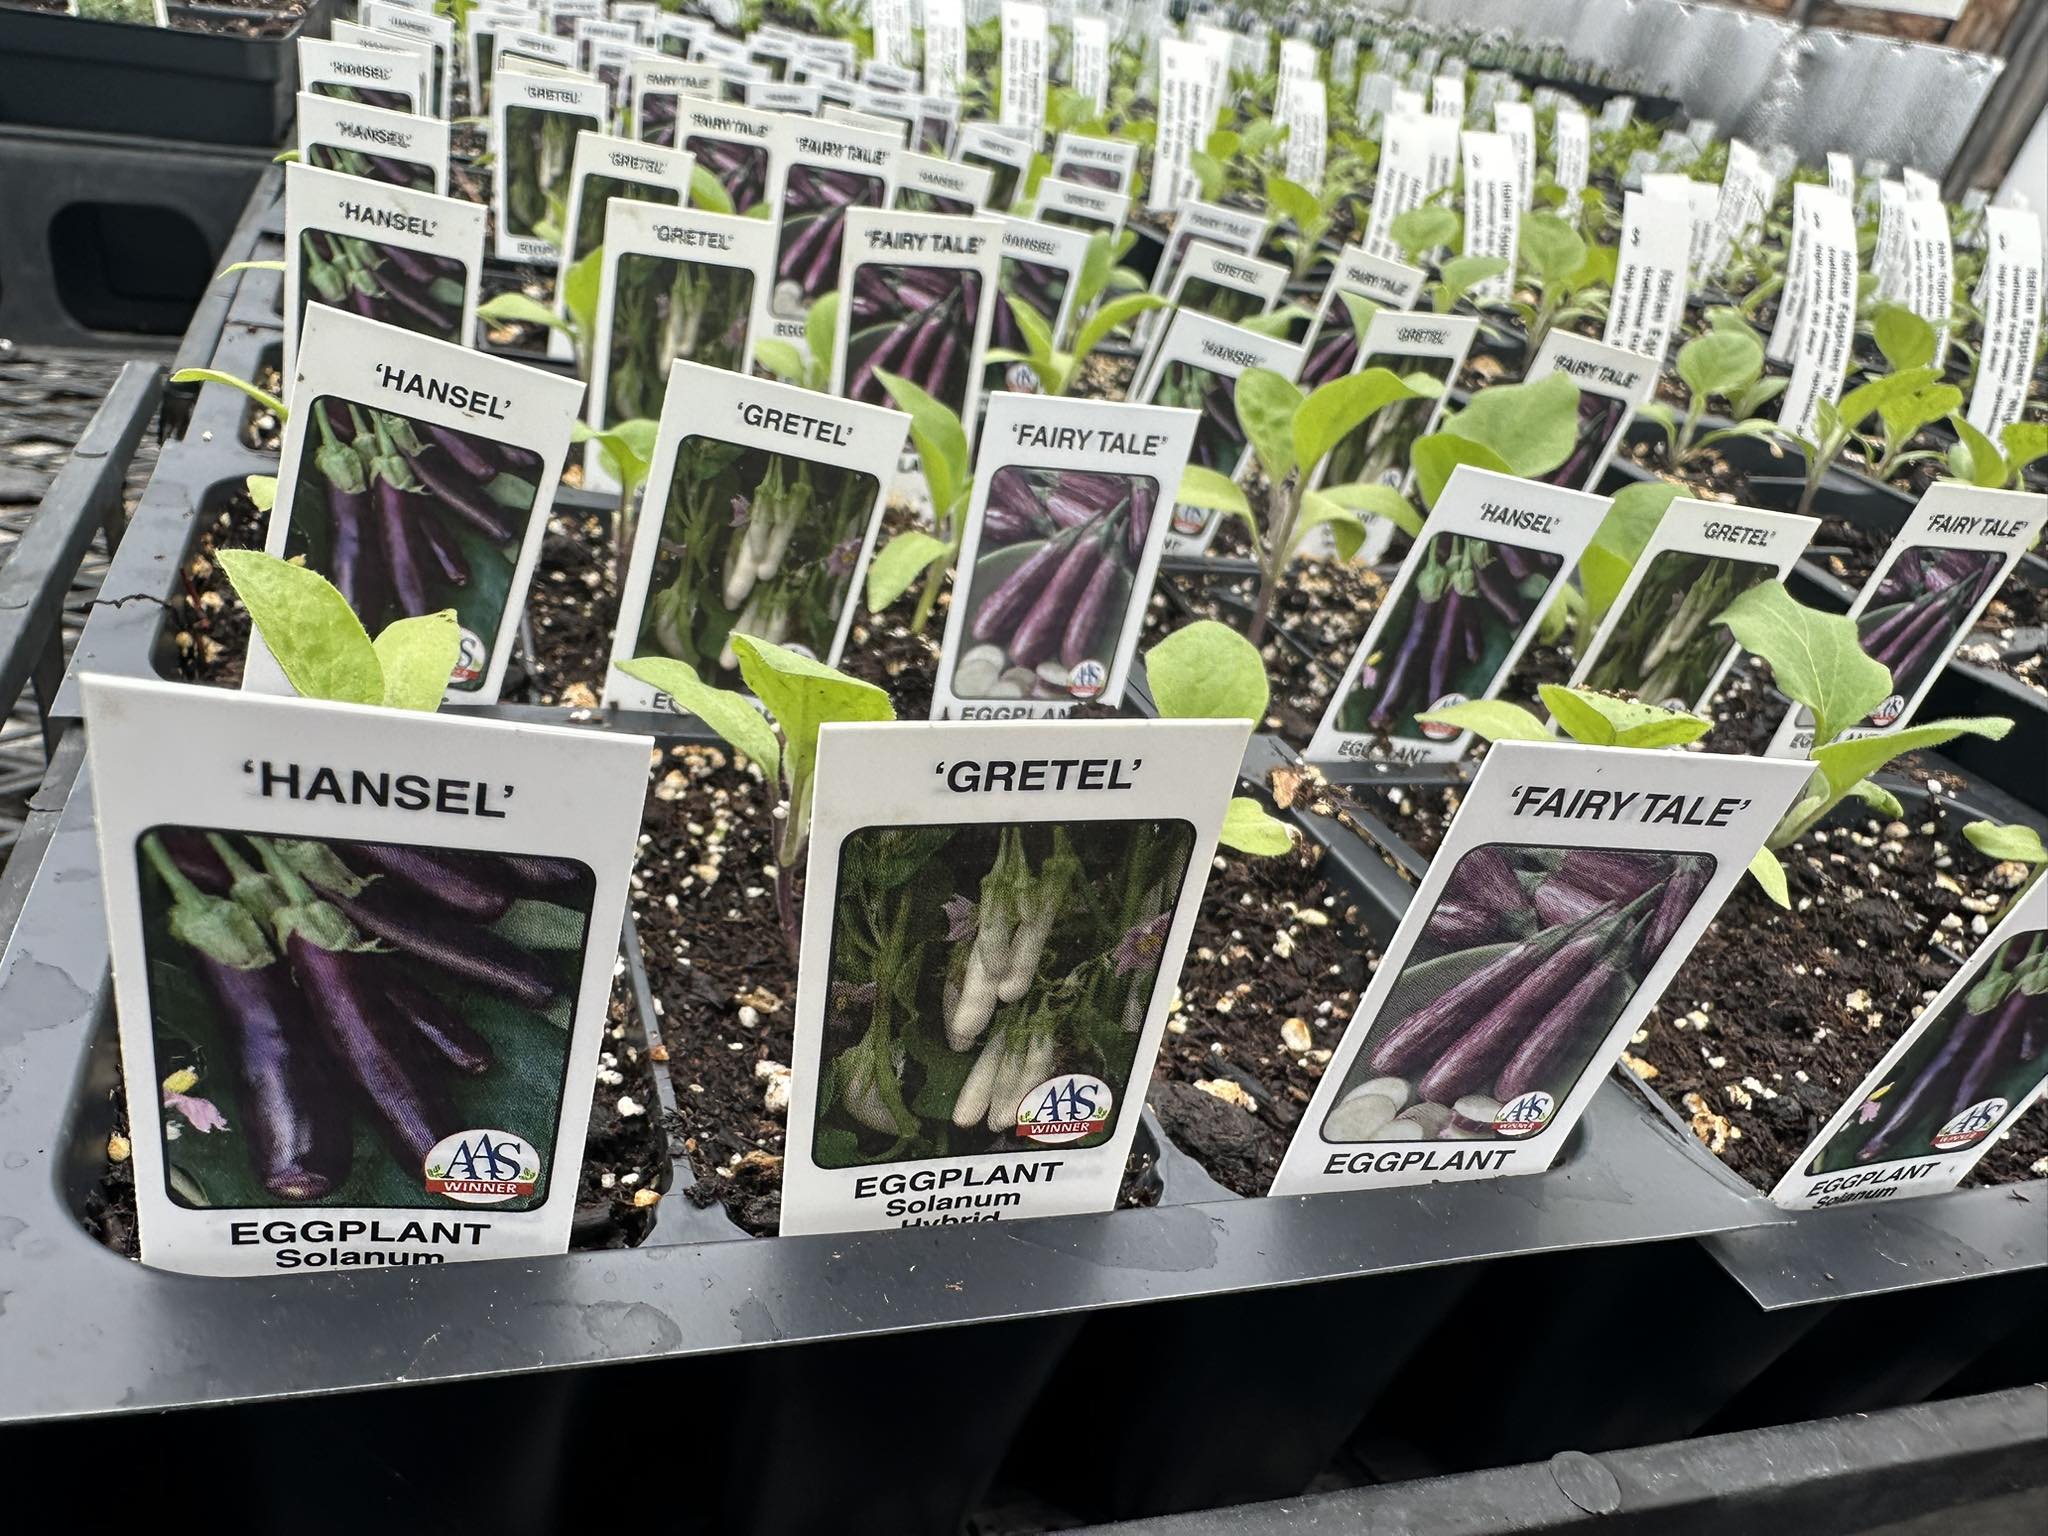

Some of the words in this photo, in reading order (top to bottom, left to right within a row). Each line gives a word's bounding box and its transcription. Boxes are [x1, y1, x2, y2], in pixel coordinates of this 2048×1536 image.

[338, 200, 438, 238] 'HANSEL'
[375, 362, 512, 421] 'HANSEL'
[736, 401, 854, 447] 'GRETEL'
[1011, 423, 1093, 452] 'FAIRY
[1098, 430, 1169, 457] TALE'
[1480, 502, 1561, 535] 'HANSEL'
[1702, 520, 1777, 547] 'GRETEL'
[1928, 513, 1979, 534] 'FAIRY
[1977, 517, 2029, 538] TALE'
[243, 758, 515, 820] 'HANSEL'
[935, 758, 1143, 793] 'GRETEL'
[1510, 784, 1640, 821] 'FAIRY
[1639, 792, 1752, 827] TALE'
[1030, 1078, 1100, 1122] AAS
[1501, 1092, 1550, 1122] AAS
[1029, 1121, 1091, 1134] WINNER
[443, 1132, 522, 1181] AAS
[1323, 1150, 1517, 1175] EGGPLANT
[443, 1179, 518, 1195] WINNER
[854, 1161, 1064, 1199] EGGPLANT
[1806, 1161, 1941, 1199] EGGPLANT
[885, 1190, 1022, 1217] Solanum
[229, 1220, 492, 1246] EGGPLANT
[275, 1247, 445, 1269] Solanum
